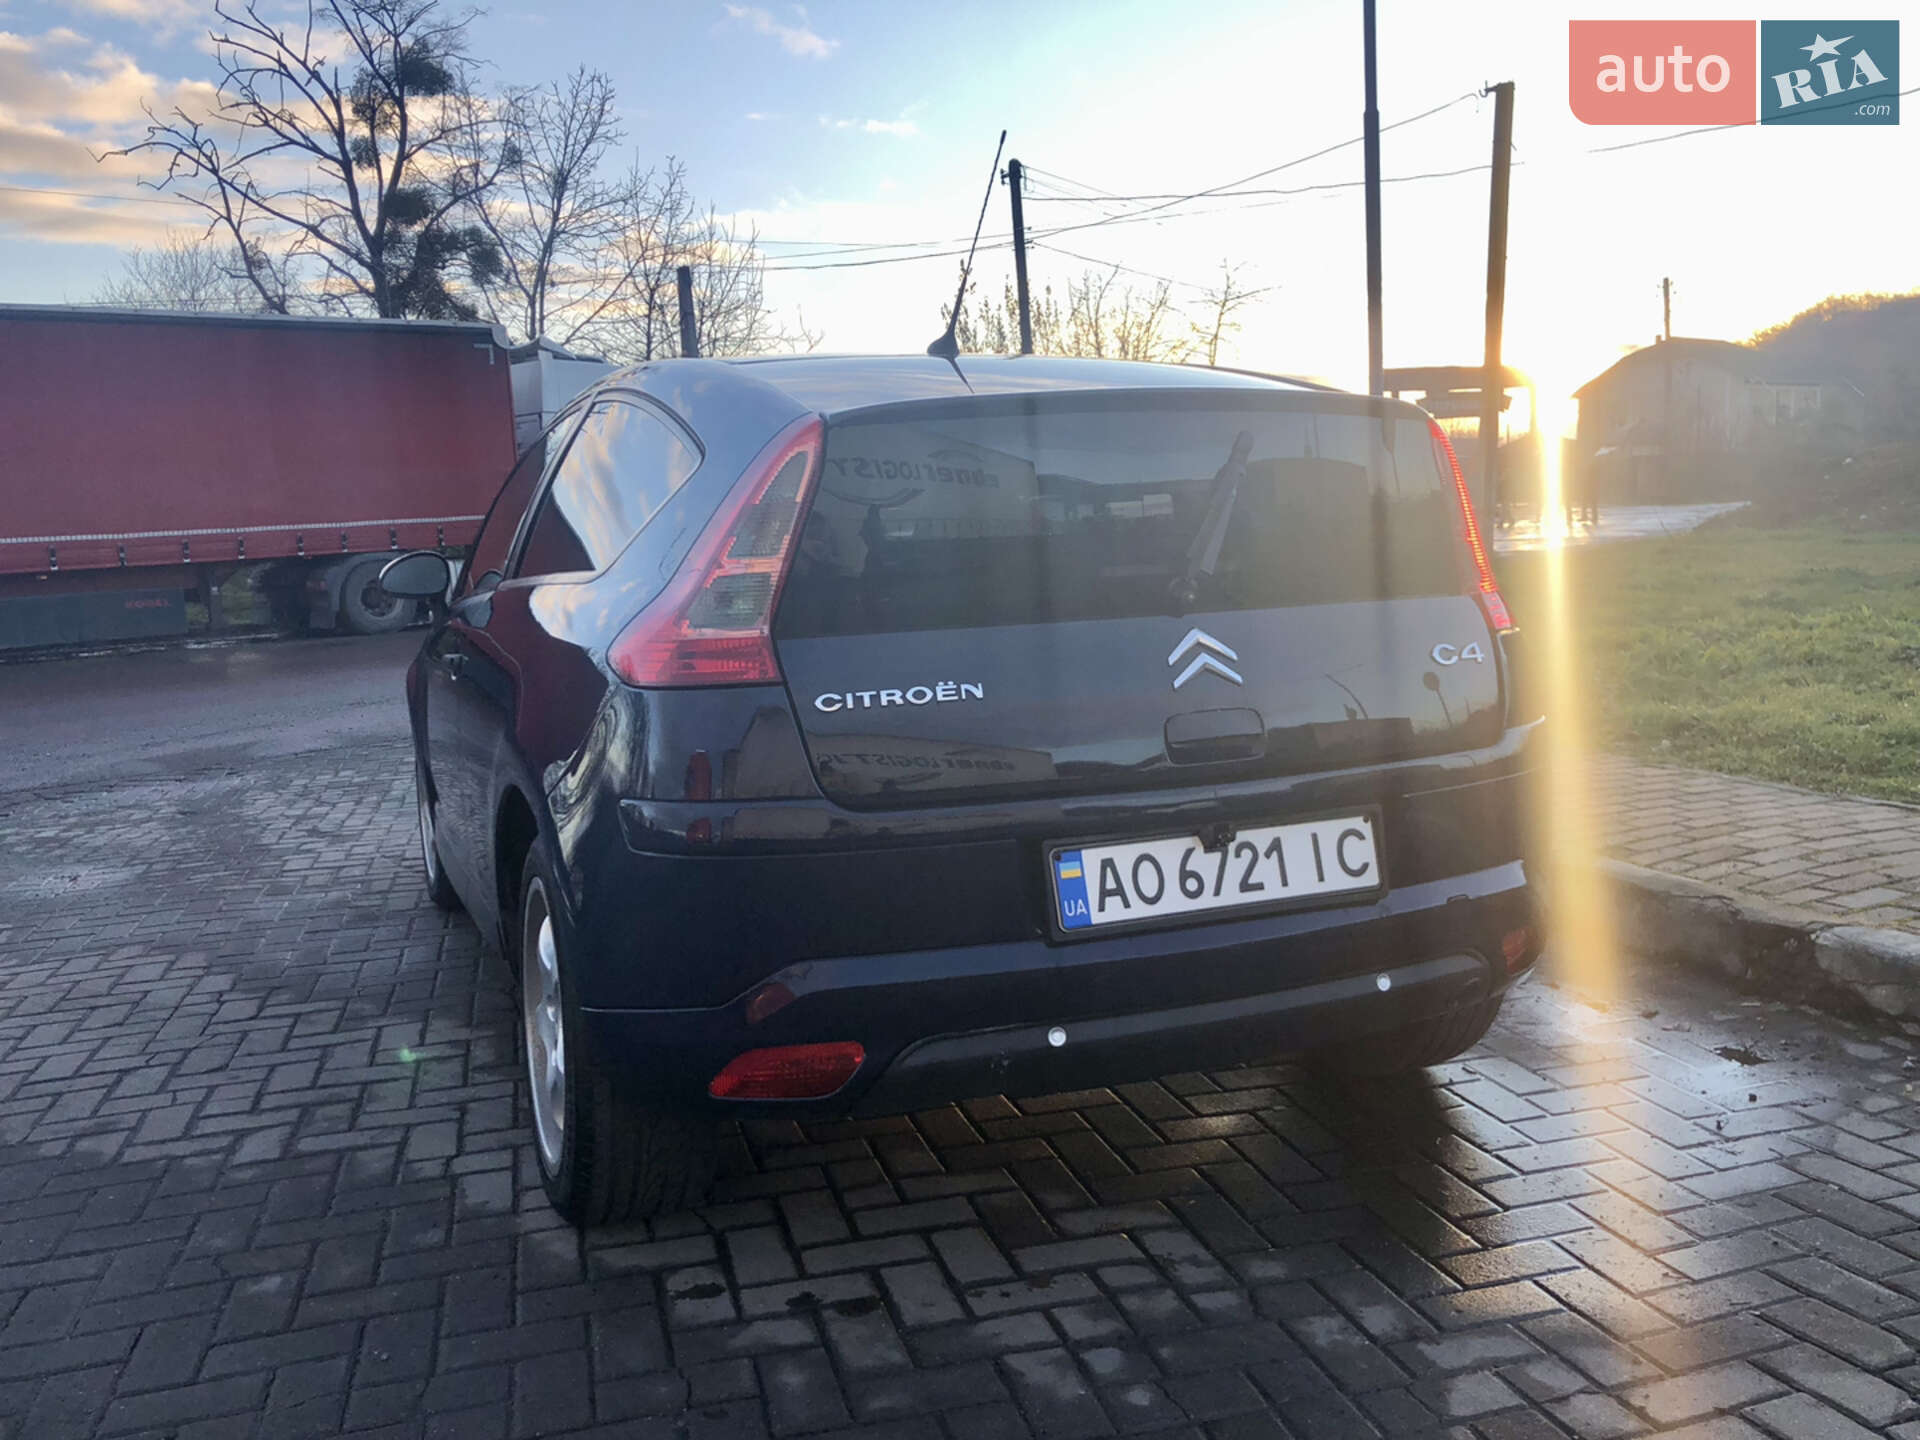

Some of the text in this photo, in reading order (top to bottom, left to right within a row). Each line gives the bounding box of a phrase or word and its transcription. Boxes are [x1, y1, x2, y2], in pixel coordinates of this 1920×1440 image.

[1432, 641, 1484, 665] C4
[814, 681, 983, 712] CITROËN
[1097, 828, 1370, 913] AO 6721 IC
[1064, 898, 1088, 917] UA
